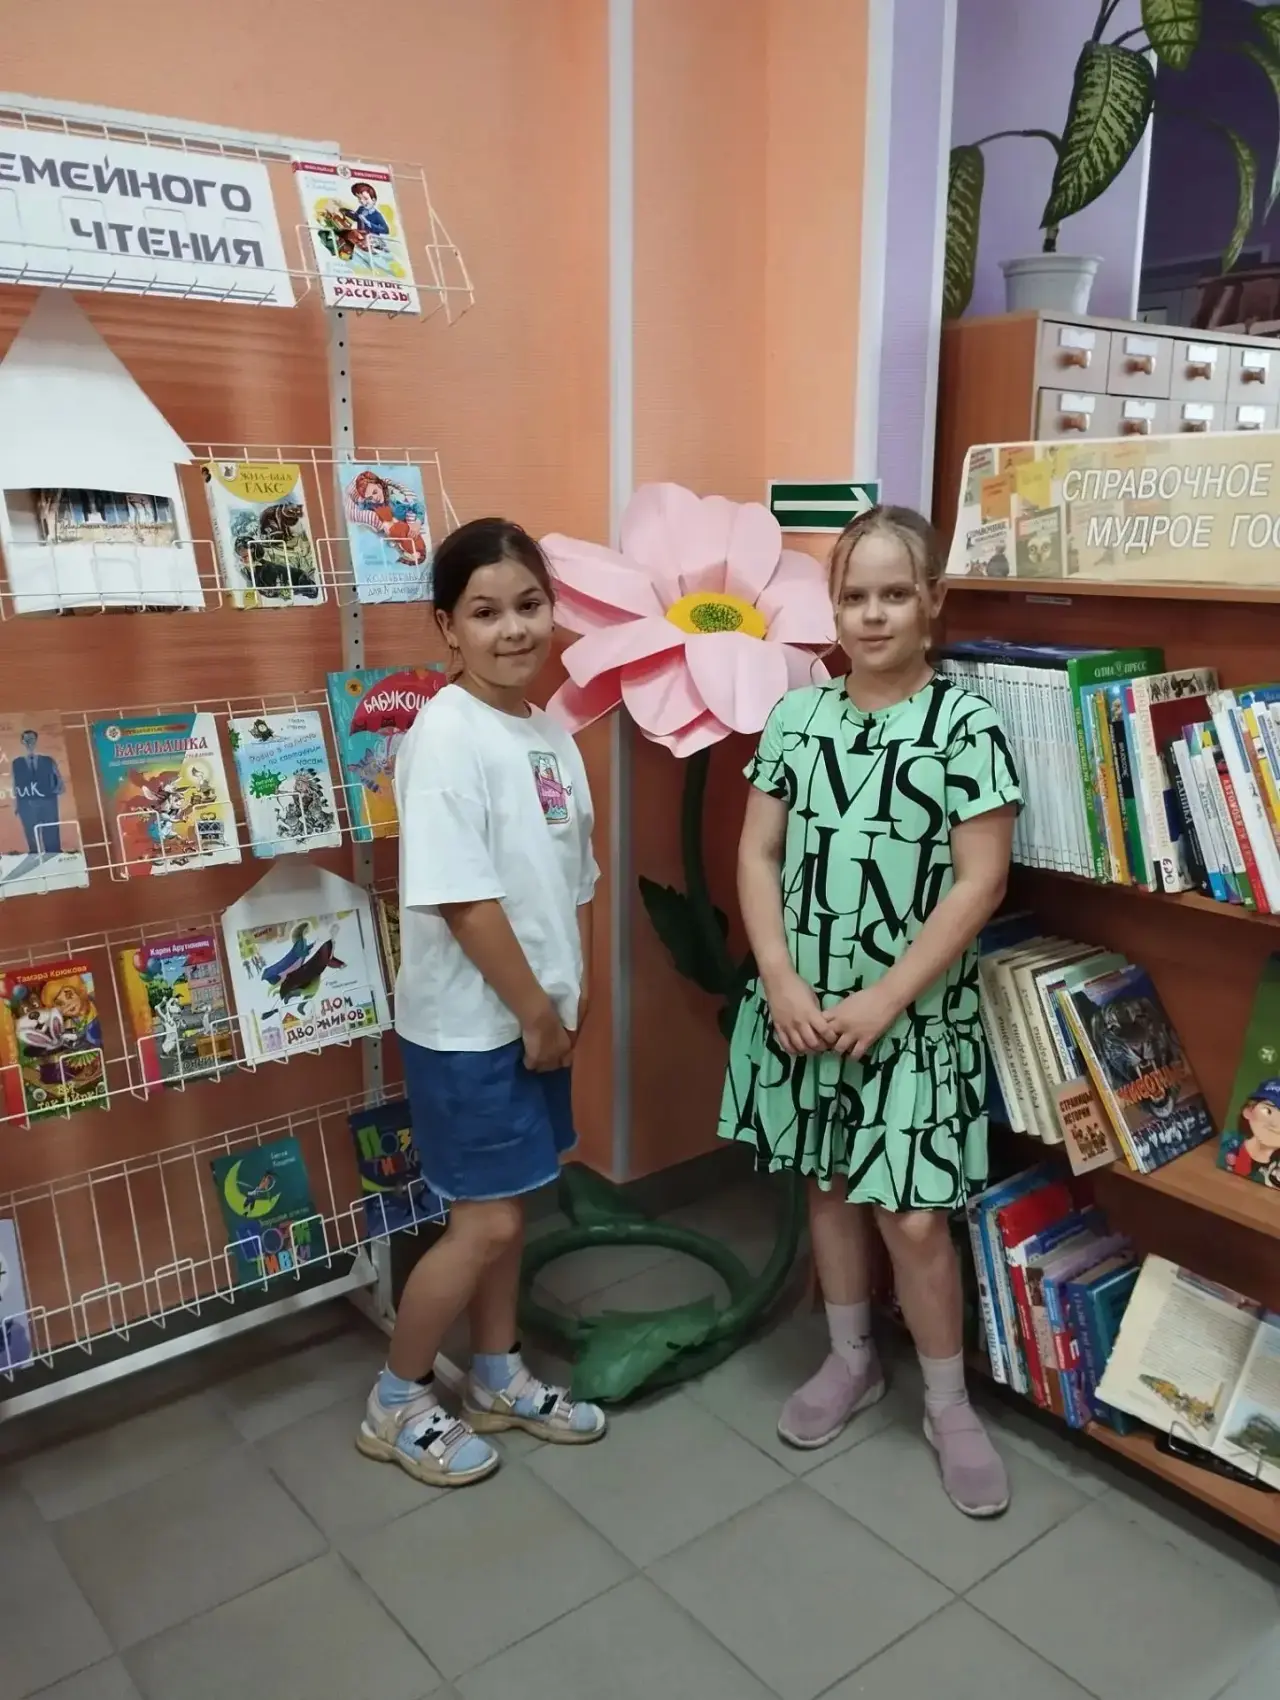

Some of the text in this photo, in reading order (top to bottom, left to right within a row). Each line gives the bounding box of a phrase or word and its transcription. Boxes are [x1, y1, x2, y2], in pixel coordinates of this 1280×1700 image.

[70, 217, 265, 268] ЧТЕНИЯ
[1062, 462, 1272, 501] СПРАВОЧНОЕ
[1086, 514, 1214, 554] МУДРОЕ
[16, 965, 88, 984] Тамара Крюкова
